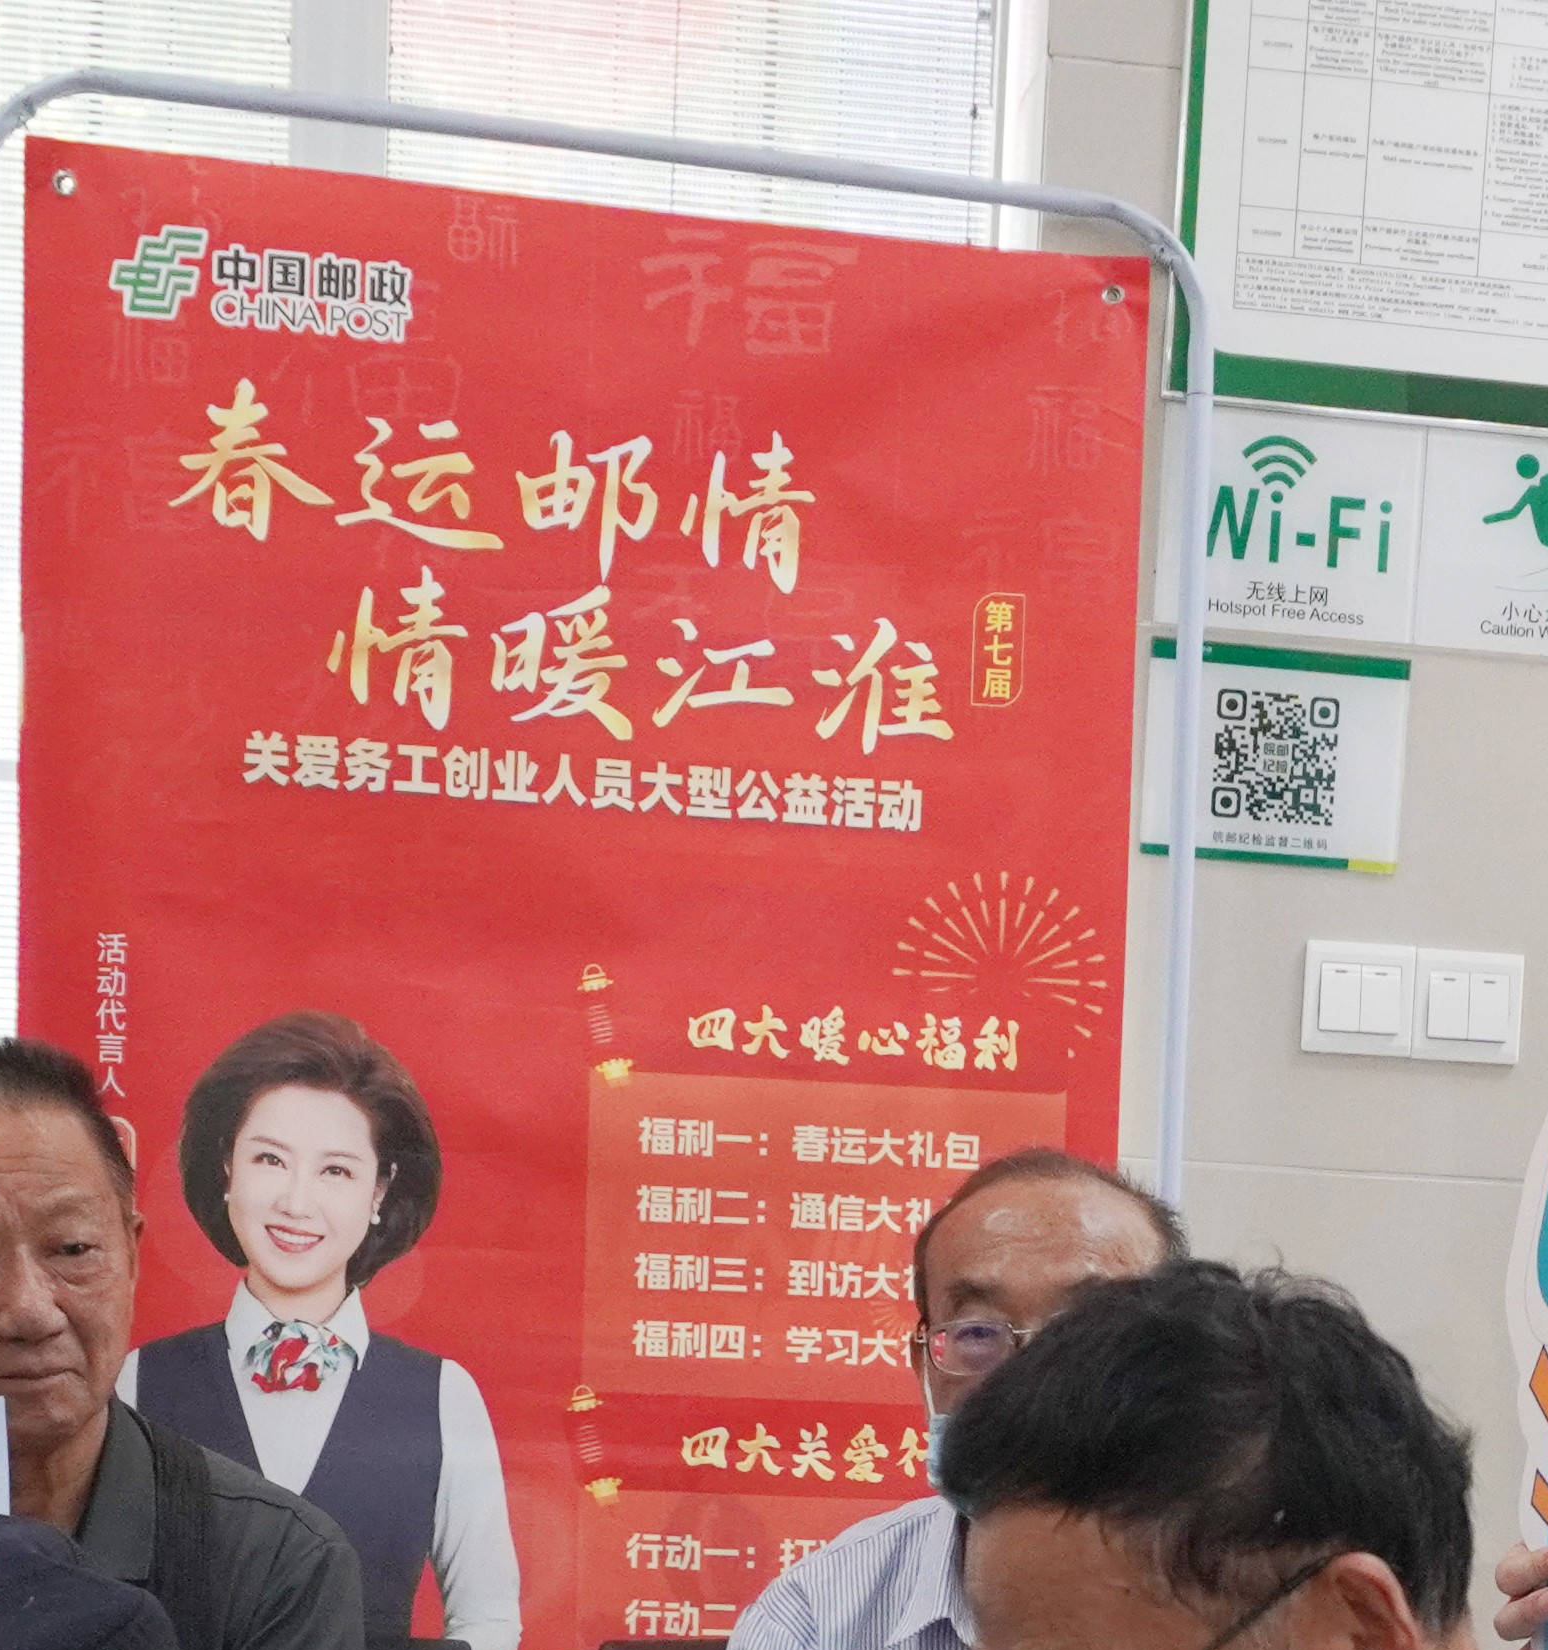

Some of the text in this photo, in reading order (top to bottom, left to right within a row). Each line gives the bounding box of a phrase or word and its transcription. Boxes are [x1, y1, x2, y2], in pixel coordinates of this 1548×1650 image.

[216, 248, 409, 308] 中国邮政
[215, 294, 409, 342] CHINA POST
[169, 378, 816, 594] 春运邮情
[1208, 598, 1364, 625] Hotspot Free Access
[1246, 581, 1328, 607] 无线上网
[326, 565, 956, 754] 情暖江淮
[981, 600, 1015, 701] 第七届
[1480, 620, 1534, 638] Caution
[242, 731, 924, 832] 关爱务工创业人员大型公益活动
[95, 932, 129, 1098] 活动代言人
[687, 1004, 1020, 1072] 四大暖心福利
